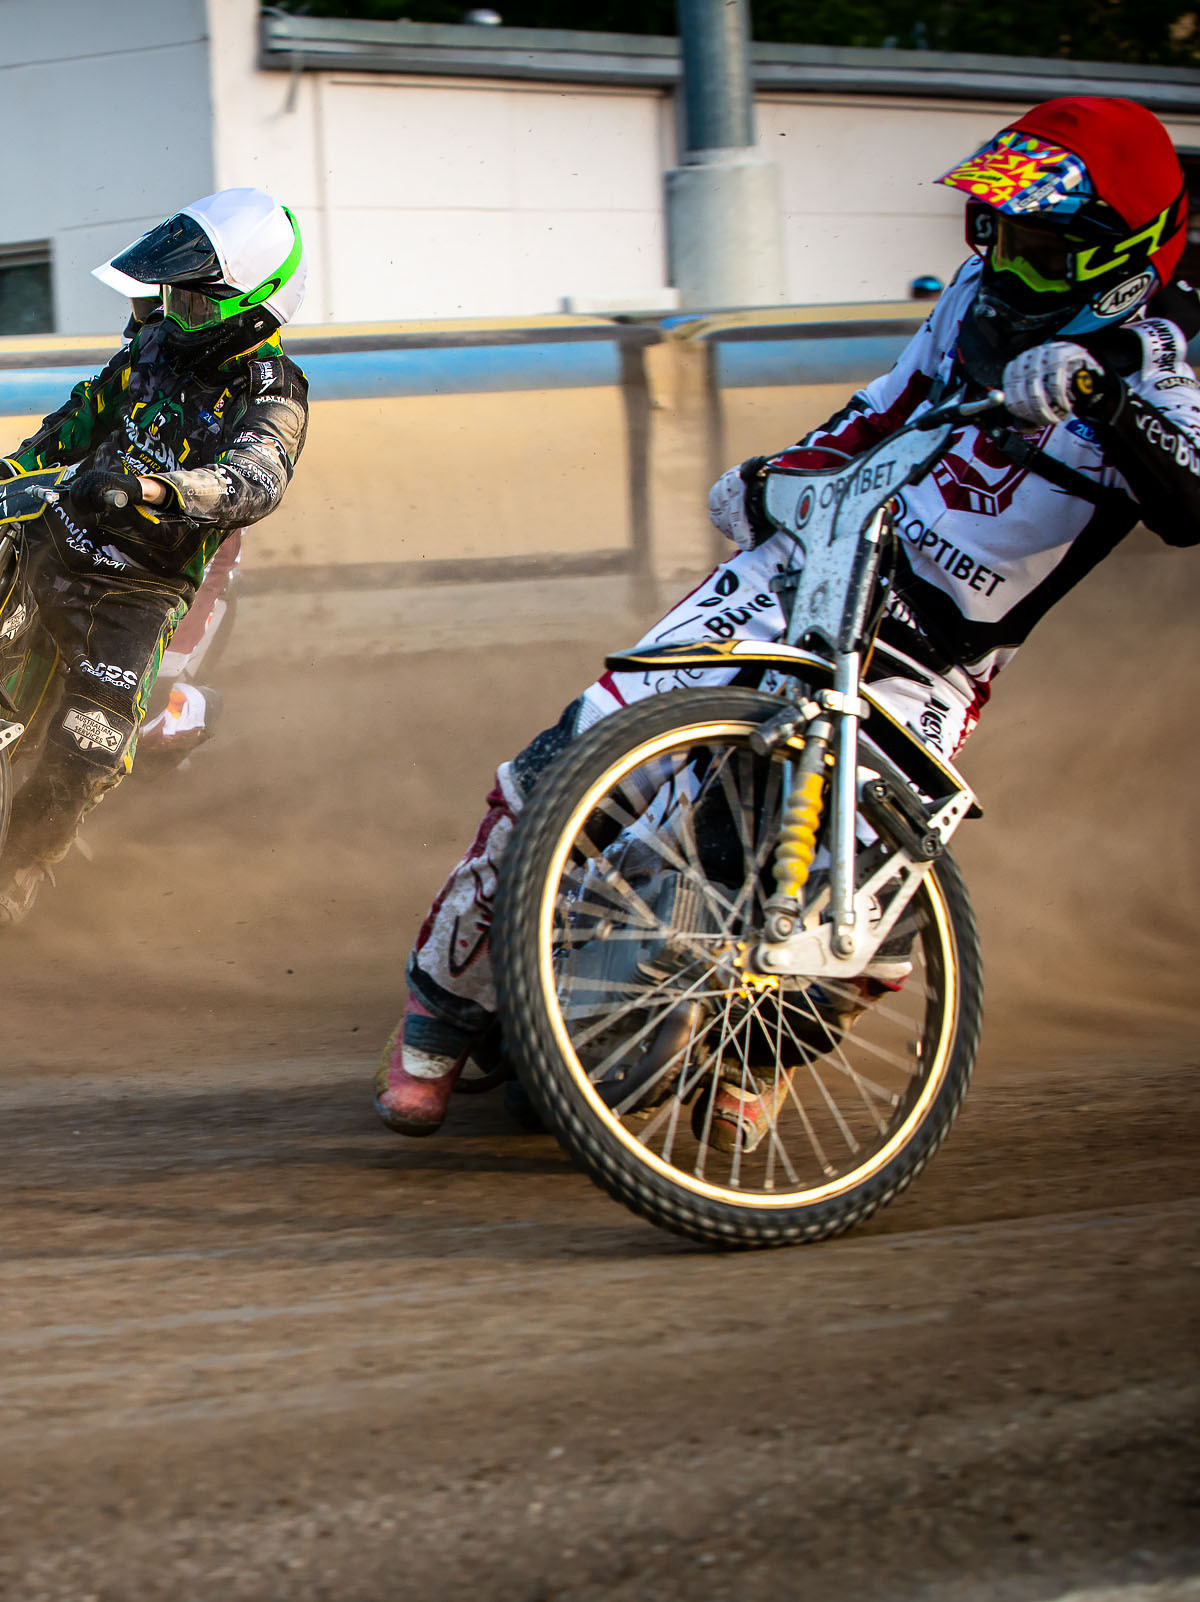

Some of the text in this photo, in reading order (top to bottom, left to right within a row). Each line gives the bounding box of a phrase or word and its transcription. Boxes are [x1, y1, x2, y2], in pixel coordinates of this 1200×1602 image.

[1101, 277, 1149, 313] Arai
[820, 461, 897, 508] OPTIBET
[905, 519, 1005, 597] OPTIBET
[75, 714, 112, 735] AUSTRALIAN
[75, 726, 103, 743] SERVICES
[82, 723, 101, 735] ROAD
